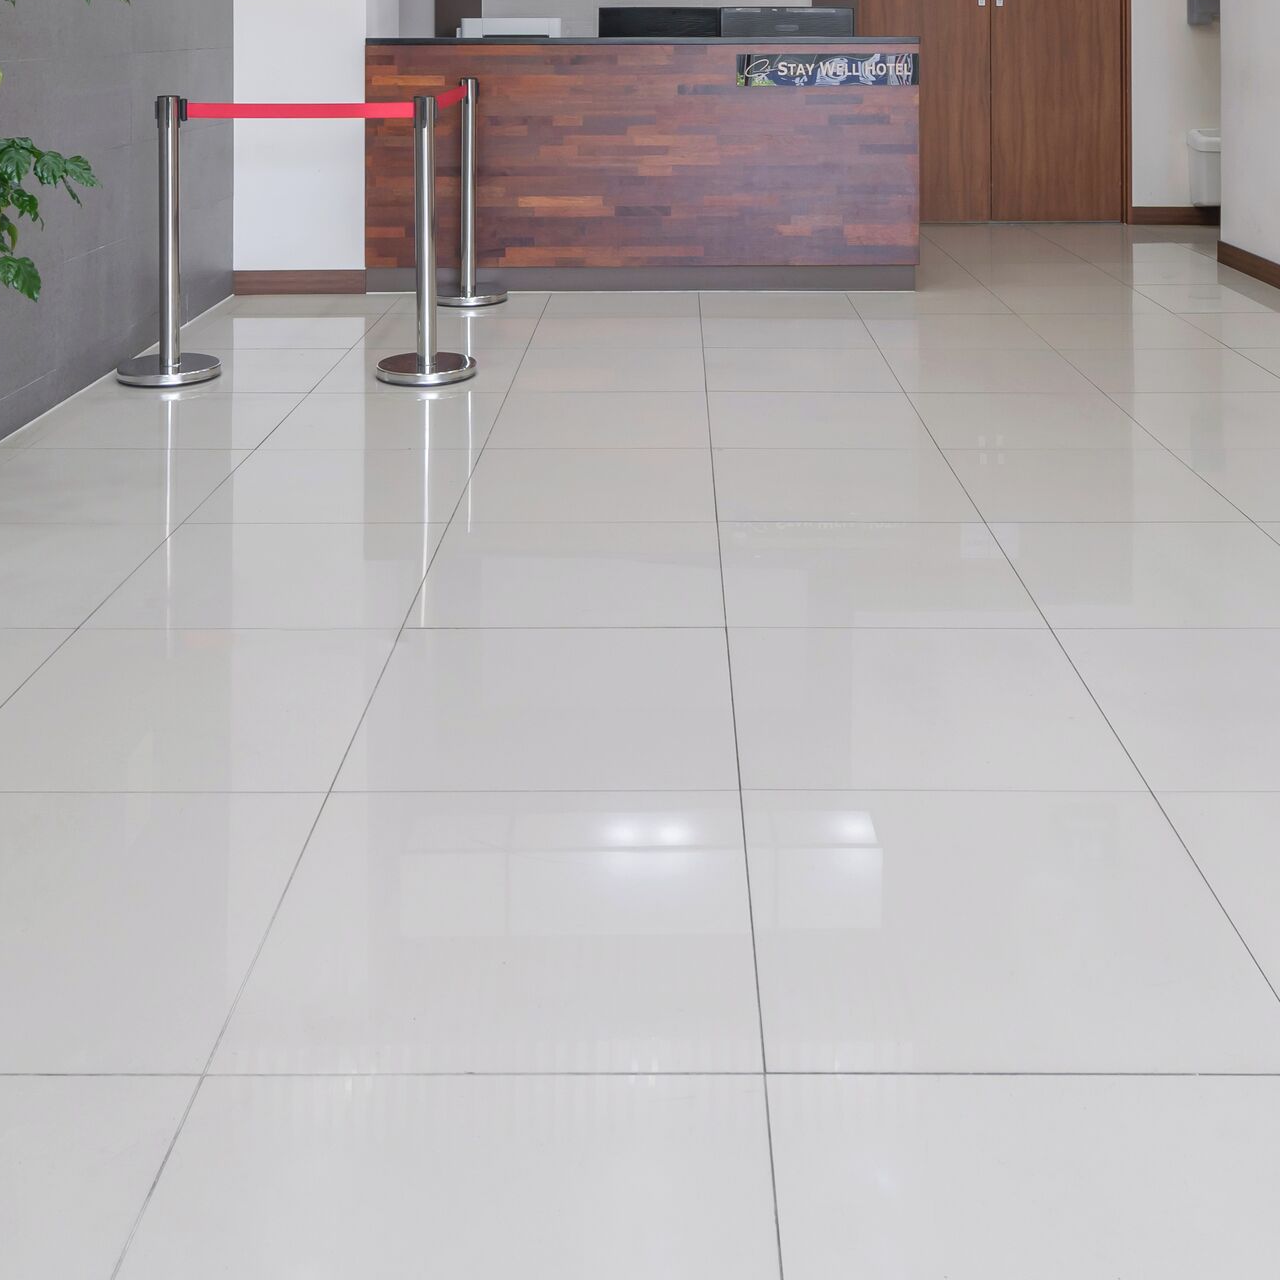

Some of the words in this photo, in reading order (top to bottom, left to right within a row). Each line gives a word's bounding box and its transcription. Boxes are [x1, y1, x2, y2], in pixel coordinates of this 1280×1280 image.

[777, 61, 815, 76] STAY
[819, 61, 861, 76] WELL
[864, 61, 912, 76] HOTEL
